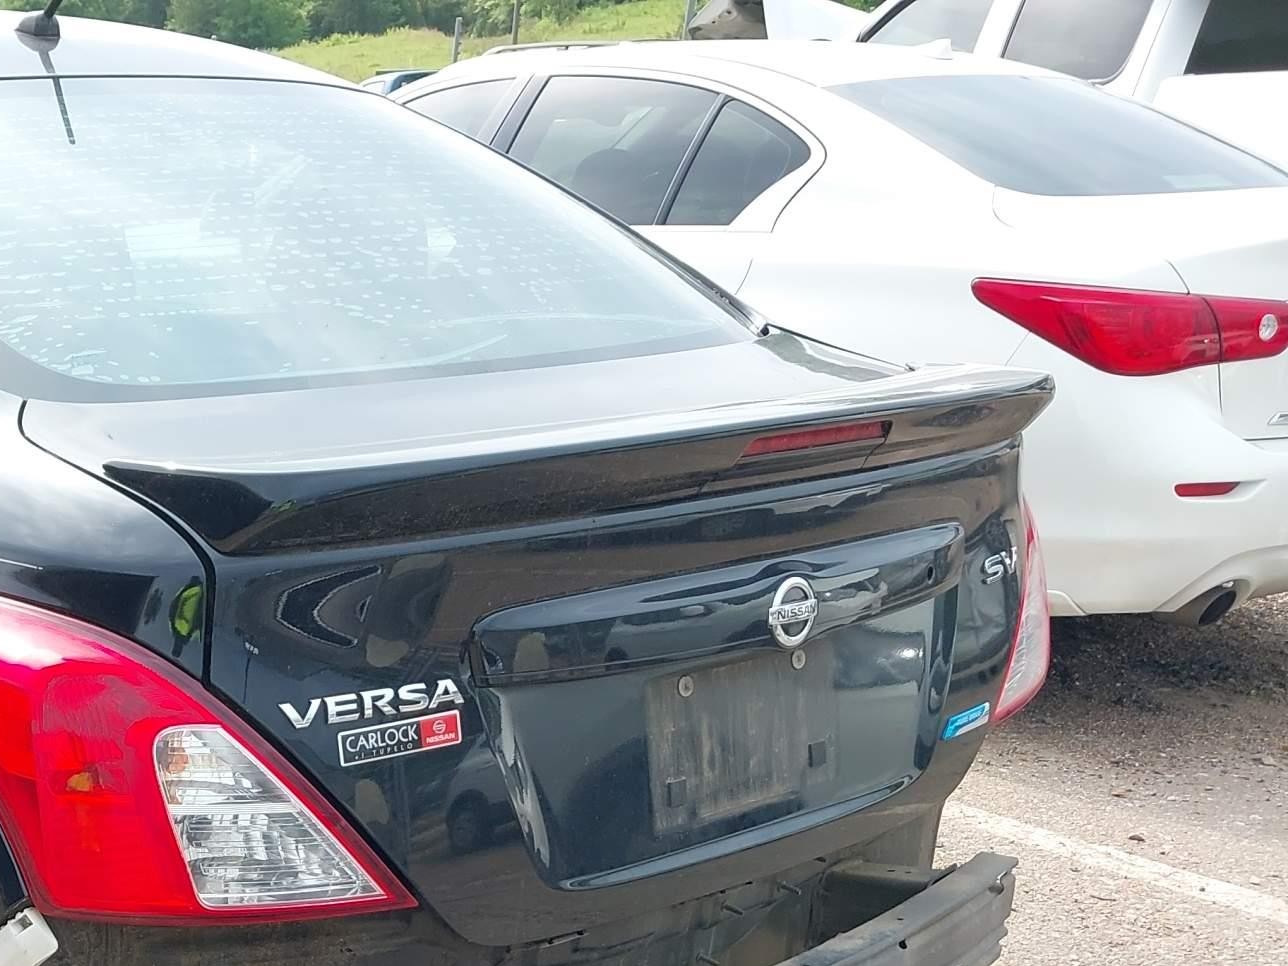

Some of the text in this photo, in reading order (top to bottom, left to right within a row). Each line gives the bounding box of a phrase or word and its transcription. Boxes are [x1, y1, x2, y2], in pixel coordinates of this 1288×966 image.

[984, 546, 1017, 584] SV
[278, 678, 464, 729] VERSA
[345, 723, 419, 753] CARLOCK
[372, 742, 414, 757] TUPELO
[425, 731, 457, 744] NISSAN
